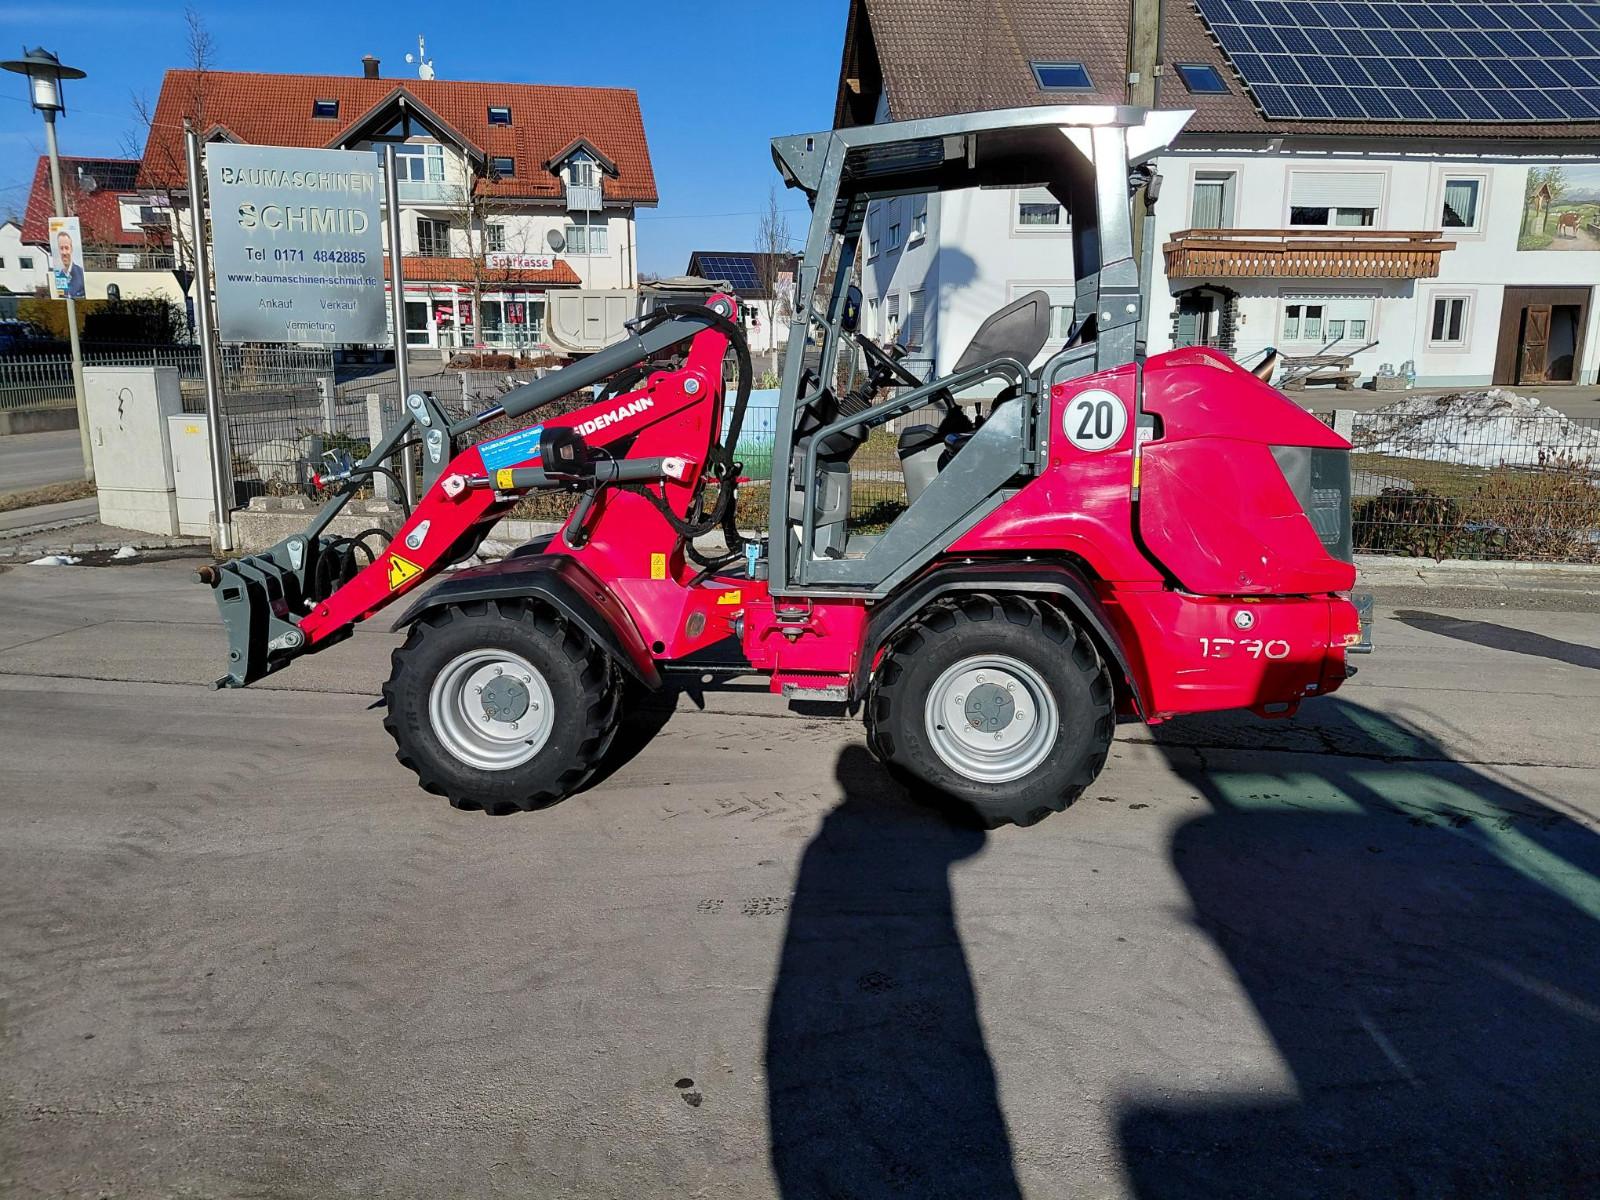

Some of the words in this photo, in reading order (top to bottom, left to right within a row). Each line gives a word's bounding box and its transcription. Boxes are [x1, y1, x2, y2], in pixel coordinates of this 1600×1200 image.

[221, 167, 375, 193] BAUMASCHINEN
[238, 203, 369, 234] SCHMID
[245, 247, 266, 261] Tel
[274, 249, 304, 262] 0171
[313, 250, 366, 264] 4842885
[491, 255, 549, 269] Sparkasse
[227, 273, 377, 286] www.baumaschinen-schmid.de
[258, 299, 293, 309] Ankauf
[320, 299, 357, 310] Verkauf
[285, 320, 336, 332] Vermietung
[1076, 400, 1113, 440] 20
